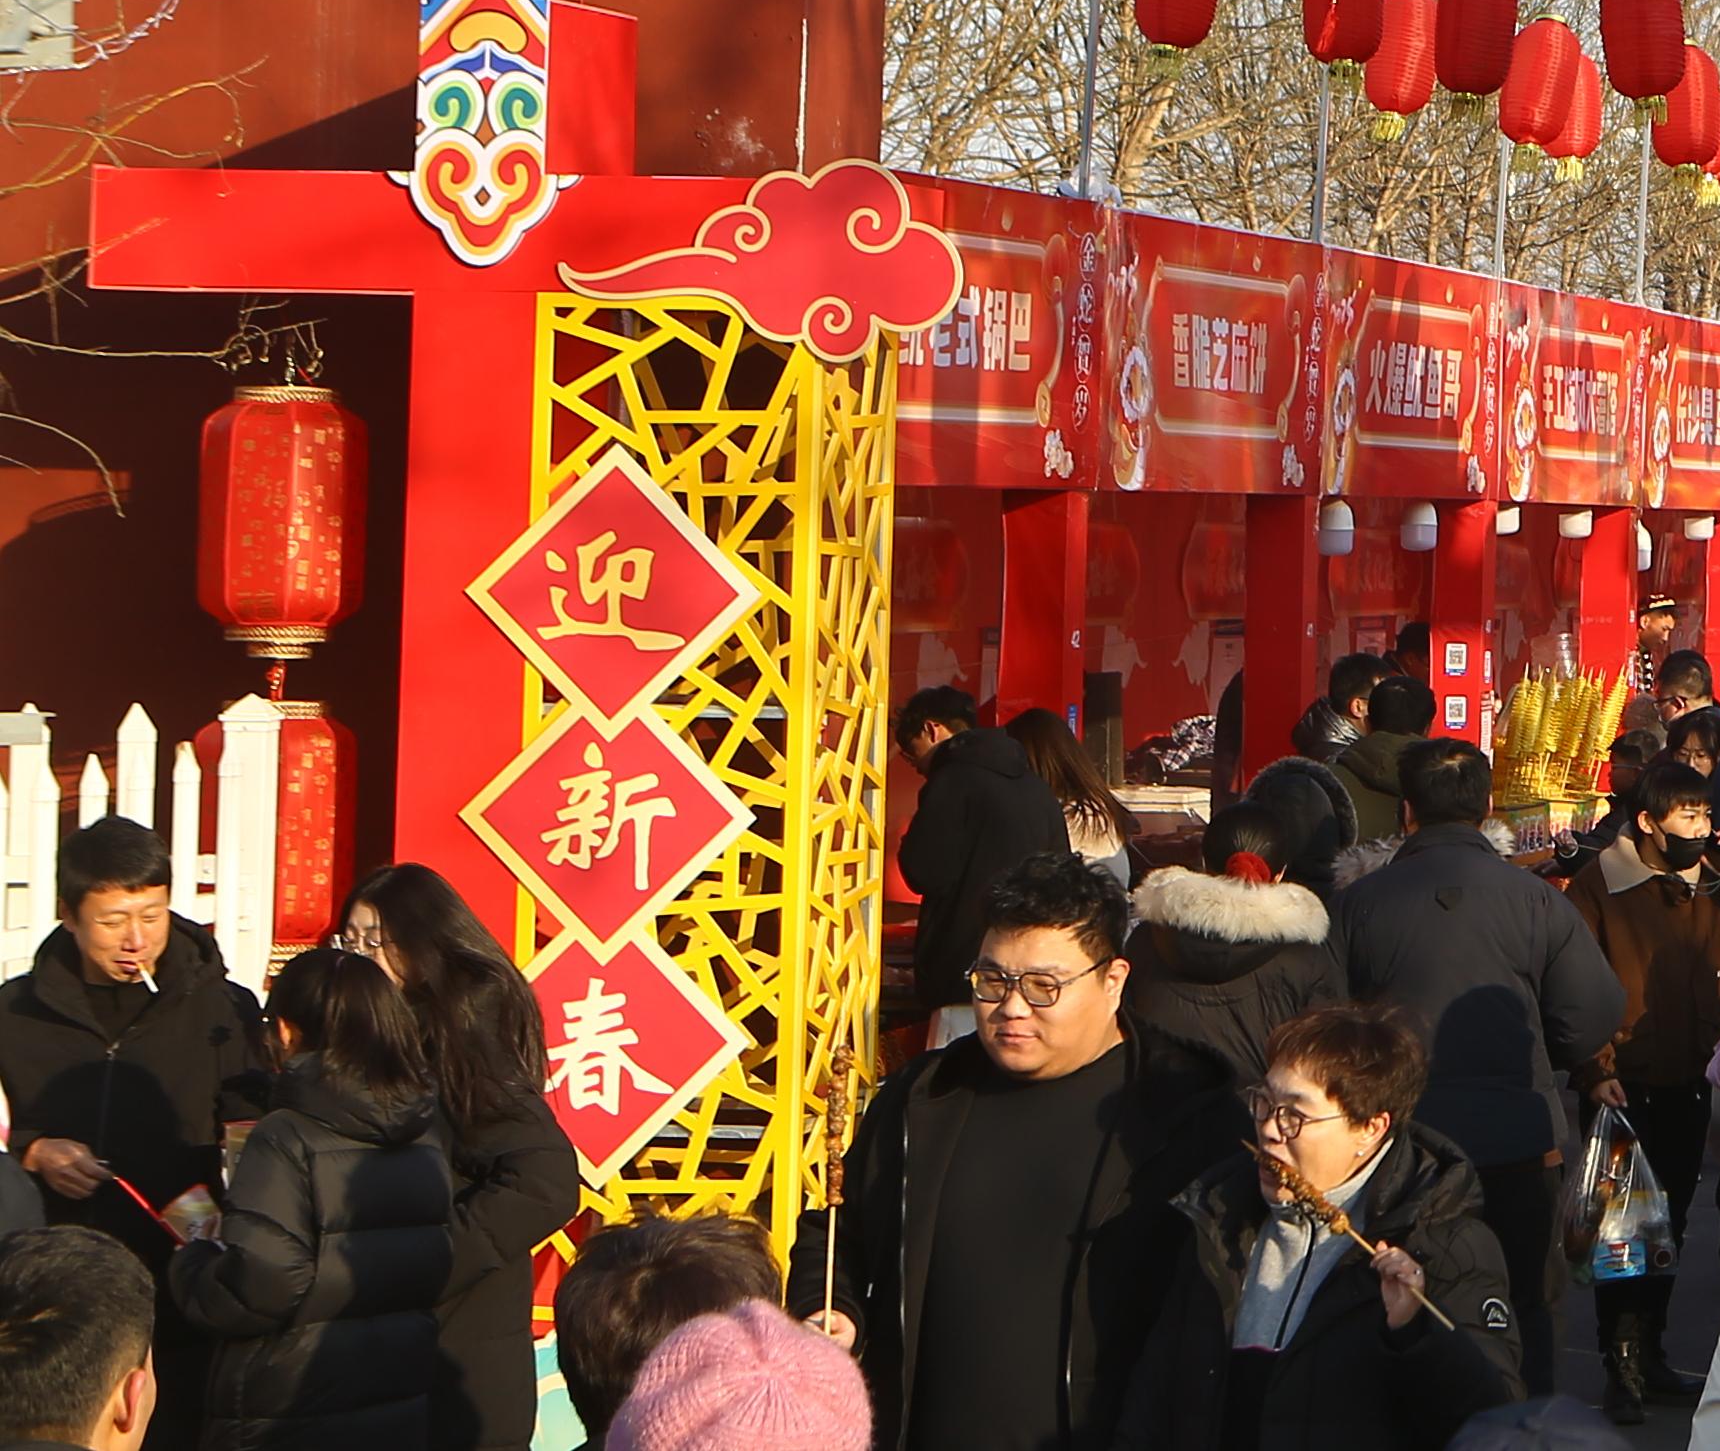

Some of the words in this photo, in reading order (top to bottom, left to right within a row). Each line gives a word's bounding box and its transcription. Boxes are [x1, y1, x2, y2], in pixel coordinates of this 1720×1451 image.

[1171, 312, 1268, 395] 香脆芝麻饼
[1365, 339, 1463, 421] 火爆鱿鱼哥
[536, 529, 687, 1117] 迎新春
